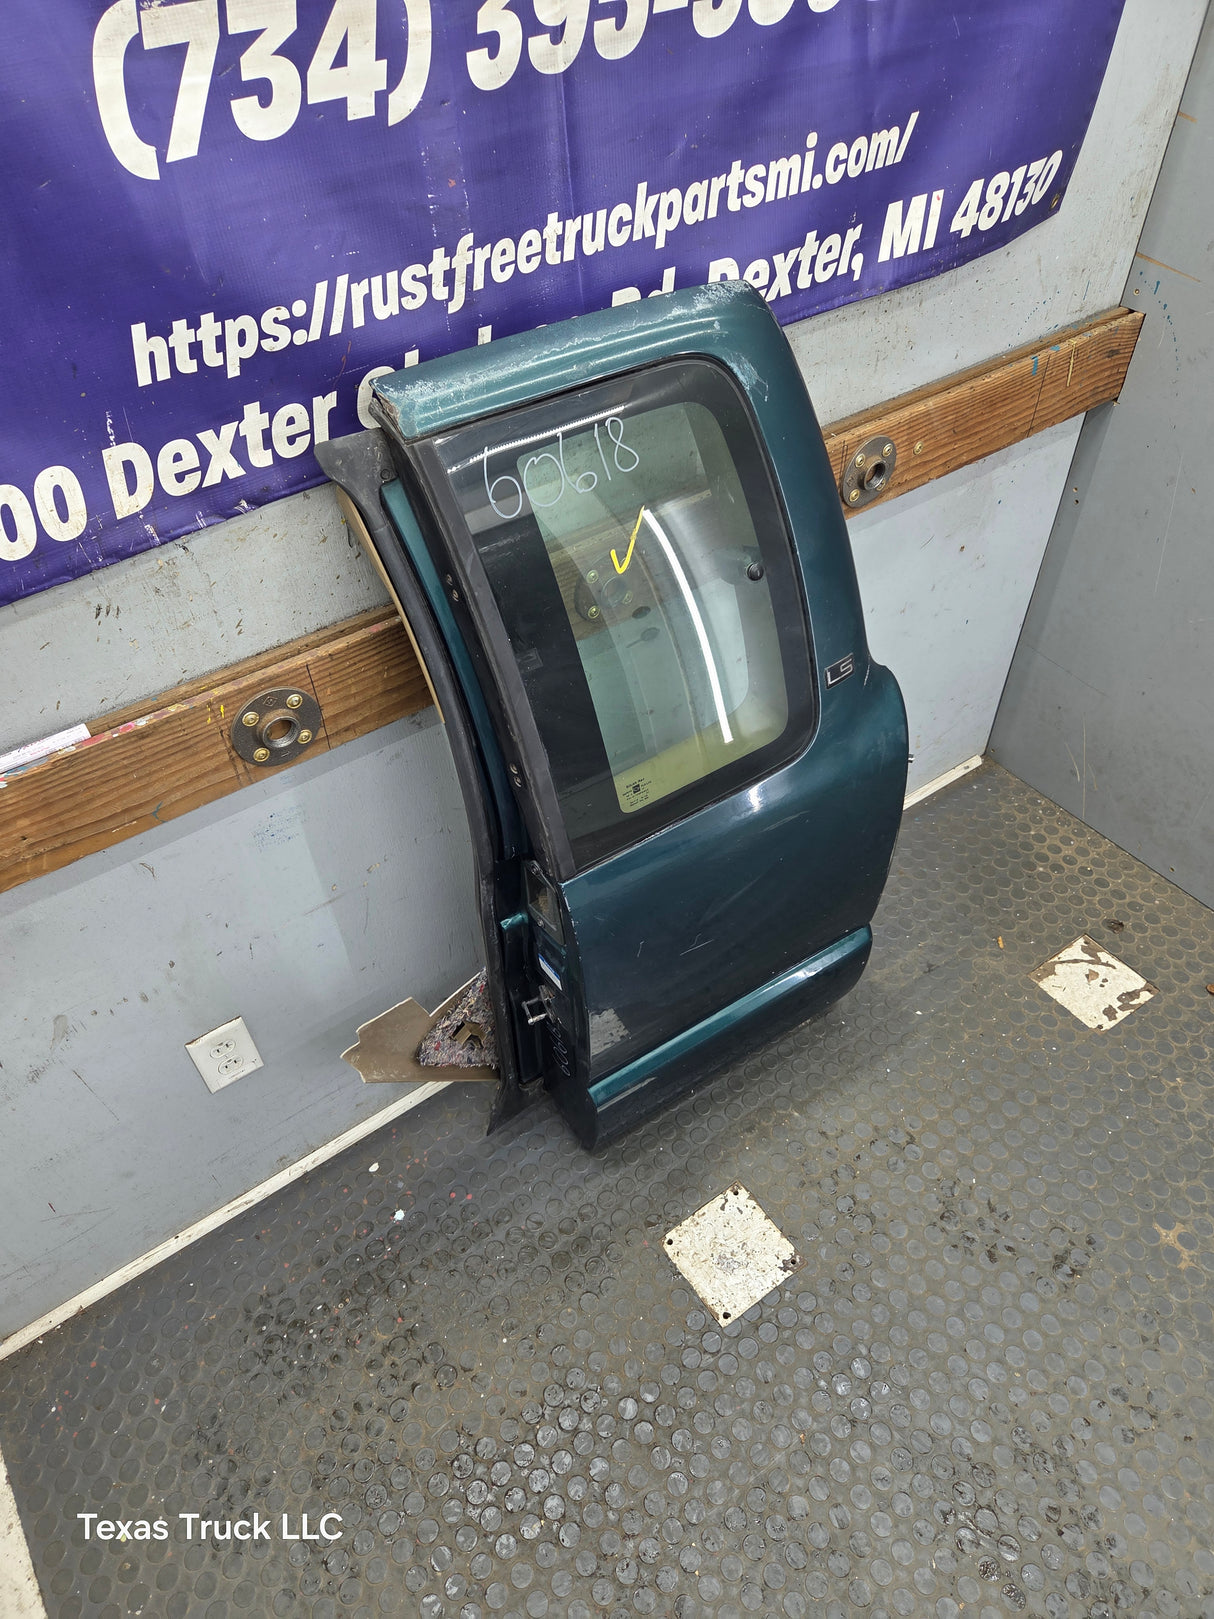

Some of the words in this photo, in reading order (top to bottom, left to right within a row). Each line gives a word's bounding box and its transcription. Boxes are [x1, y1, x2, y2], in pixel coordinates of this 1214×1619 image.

[92, 0, 432, 180] (734)
[102, 391, 337, 520] Dexter
[877, 189, 944, 263] MI
[950, 150, 1063, 239] 48130
[131, 111, 919, 387] https://rustfreetruckpartsmi.com/
[483, 417, 640, 519] 60618
[827, 657, 853, 687] LS
